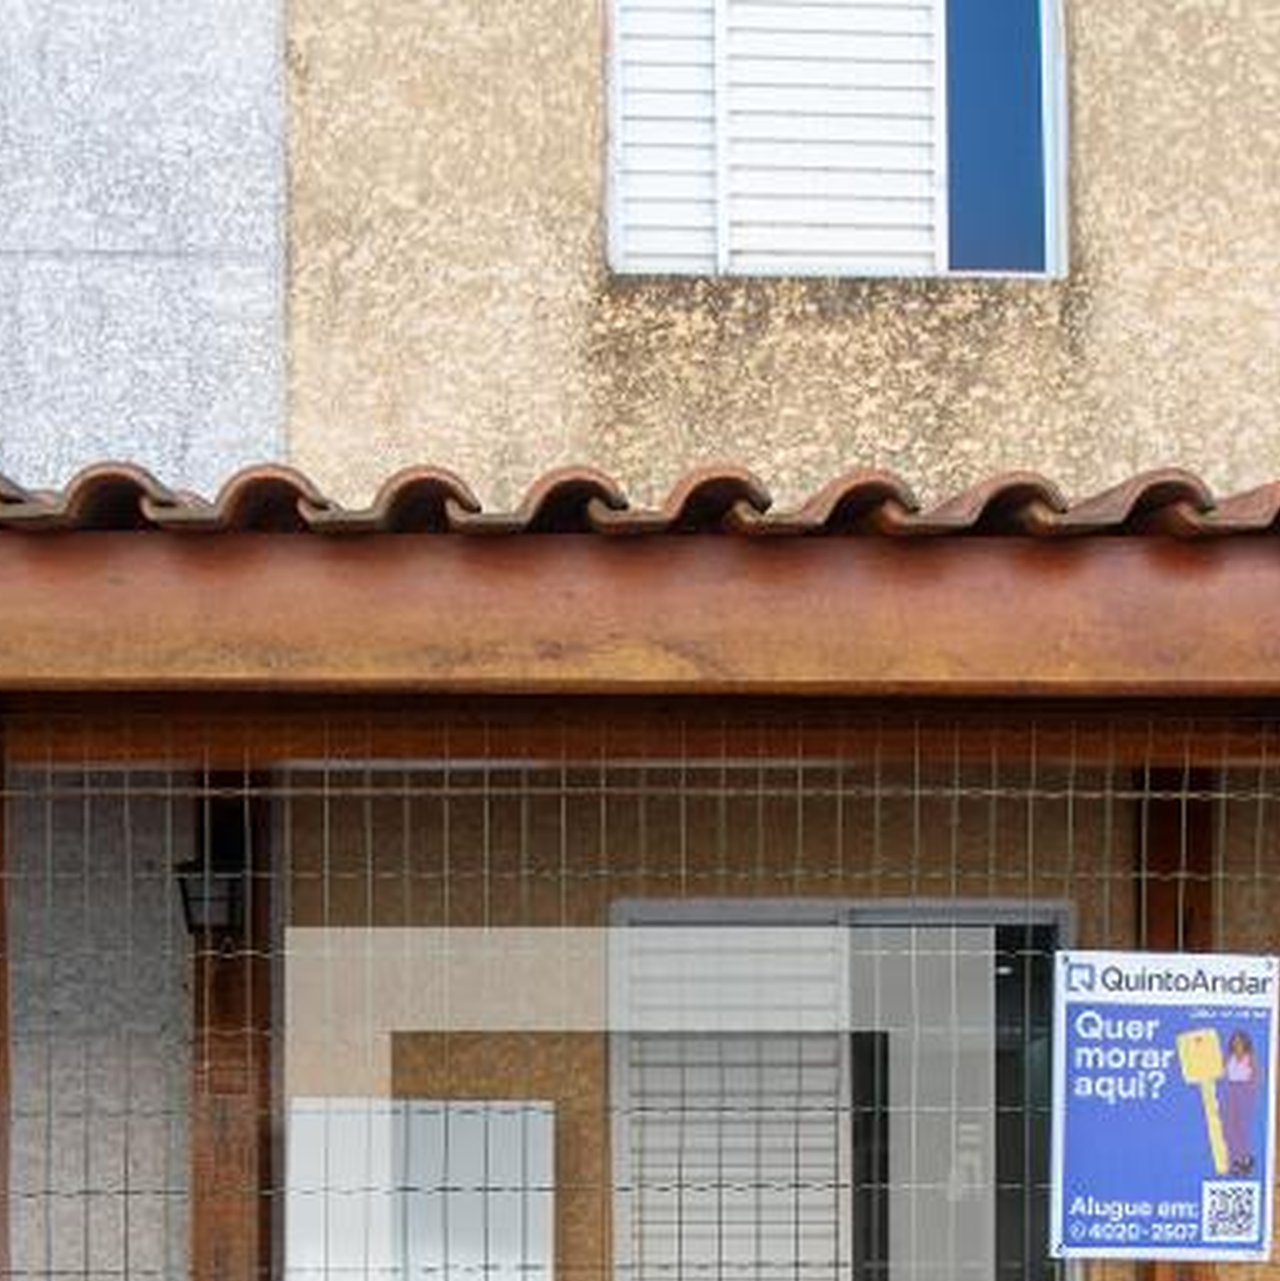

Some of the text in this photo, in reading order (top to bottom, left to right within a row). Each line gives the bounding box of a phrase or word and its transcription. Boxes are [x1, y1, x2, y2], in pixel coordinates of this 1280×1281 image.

[1100, 964, 1273, 995] QuintoAndar
[1075, 1010, 1160, 1041] Quer
[1075, 1047, 1175, 1069] morar
[1074, 1070, 1166, 1104] aqui?
[1070, 1196, 1152, 1222] Alugue
